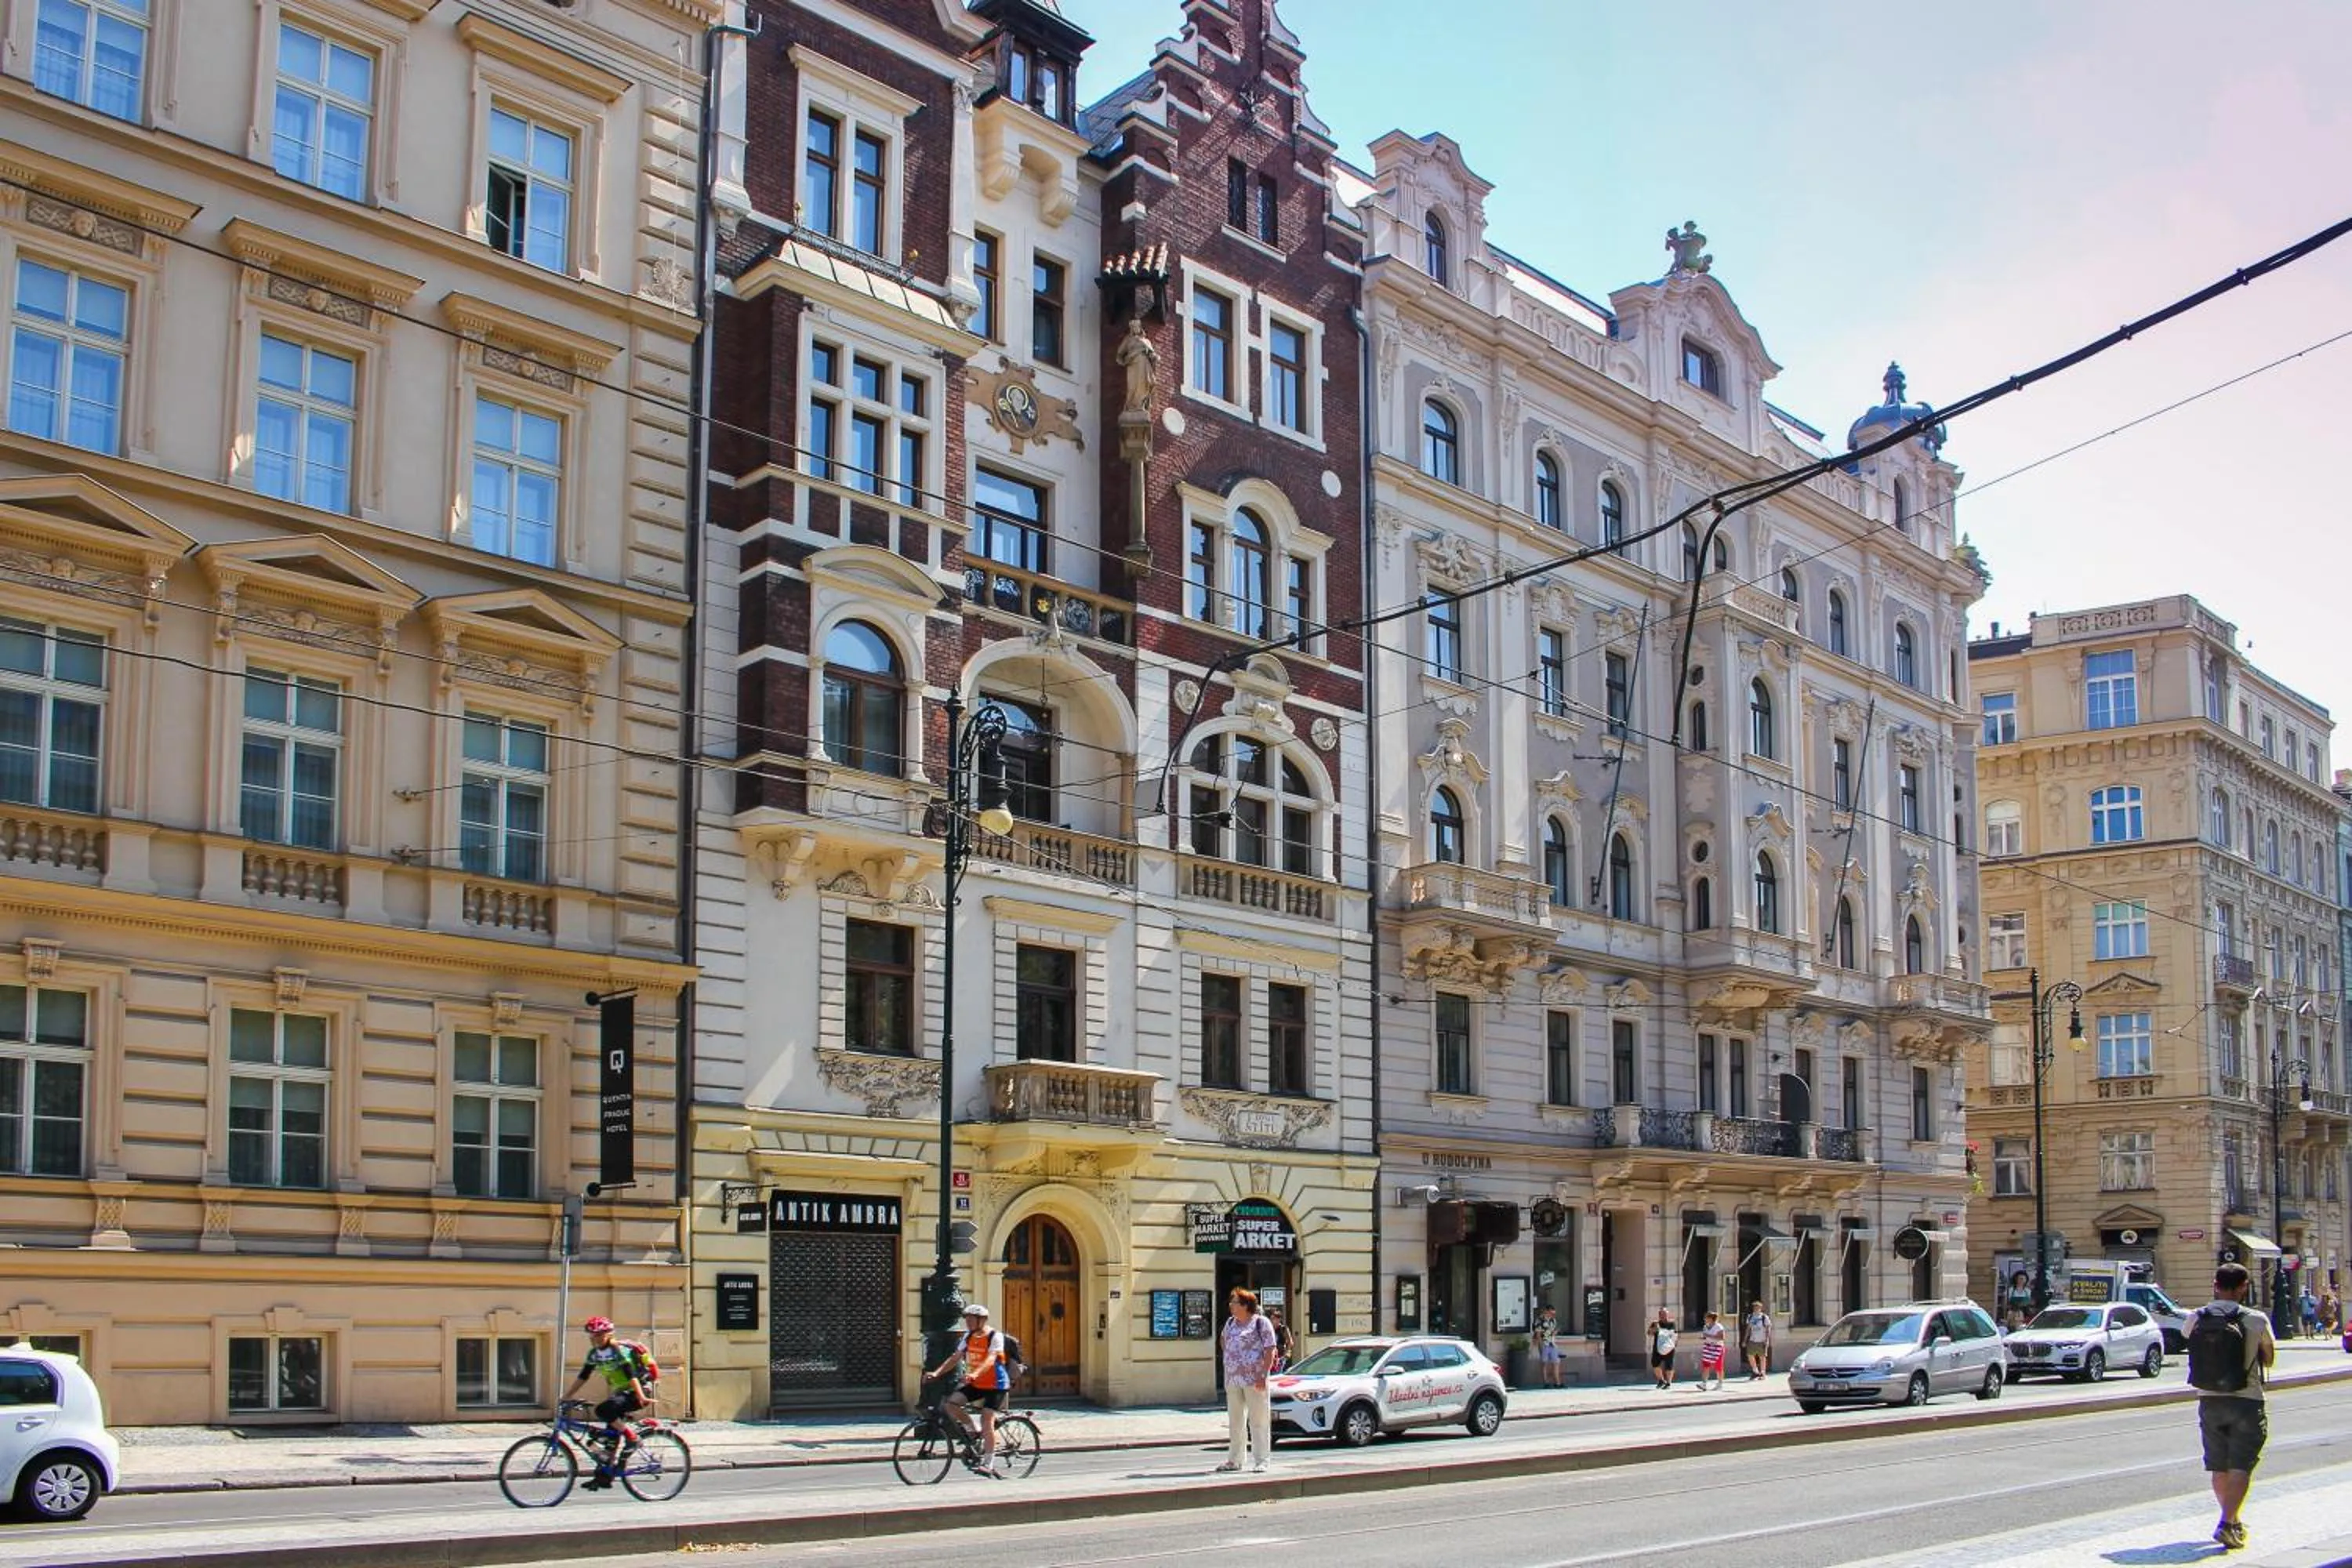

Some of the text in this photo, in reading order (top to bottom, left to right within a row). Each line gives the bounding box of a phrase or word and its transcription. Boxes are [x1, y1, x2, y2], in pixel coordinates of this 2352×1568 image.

[610, 1050, 624, 1073] Q
[775, 1200, 898, 1225] ANTIK AMBRA
[1195, 1222, 1231, 1234] MARKET
[1236, 1219, 1280, 1232] SUPER
[1234, 1232, 1296, 1250] ARKET
